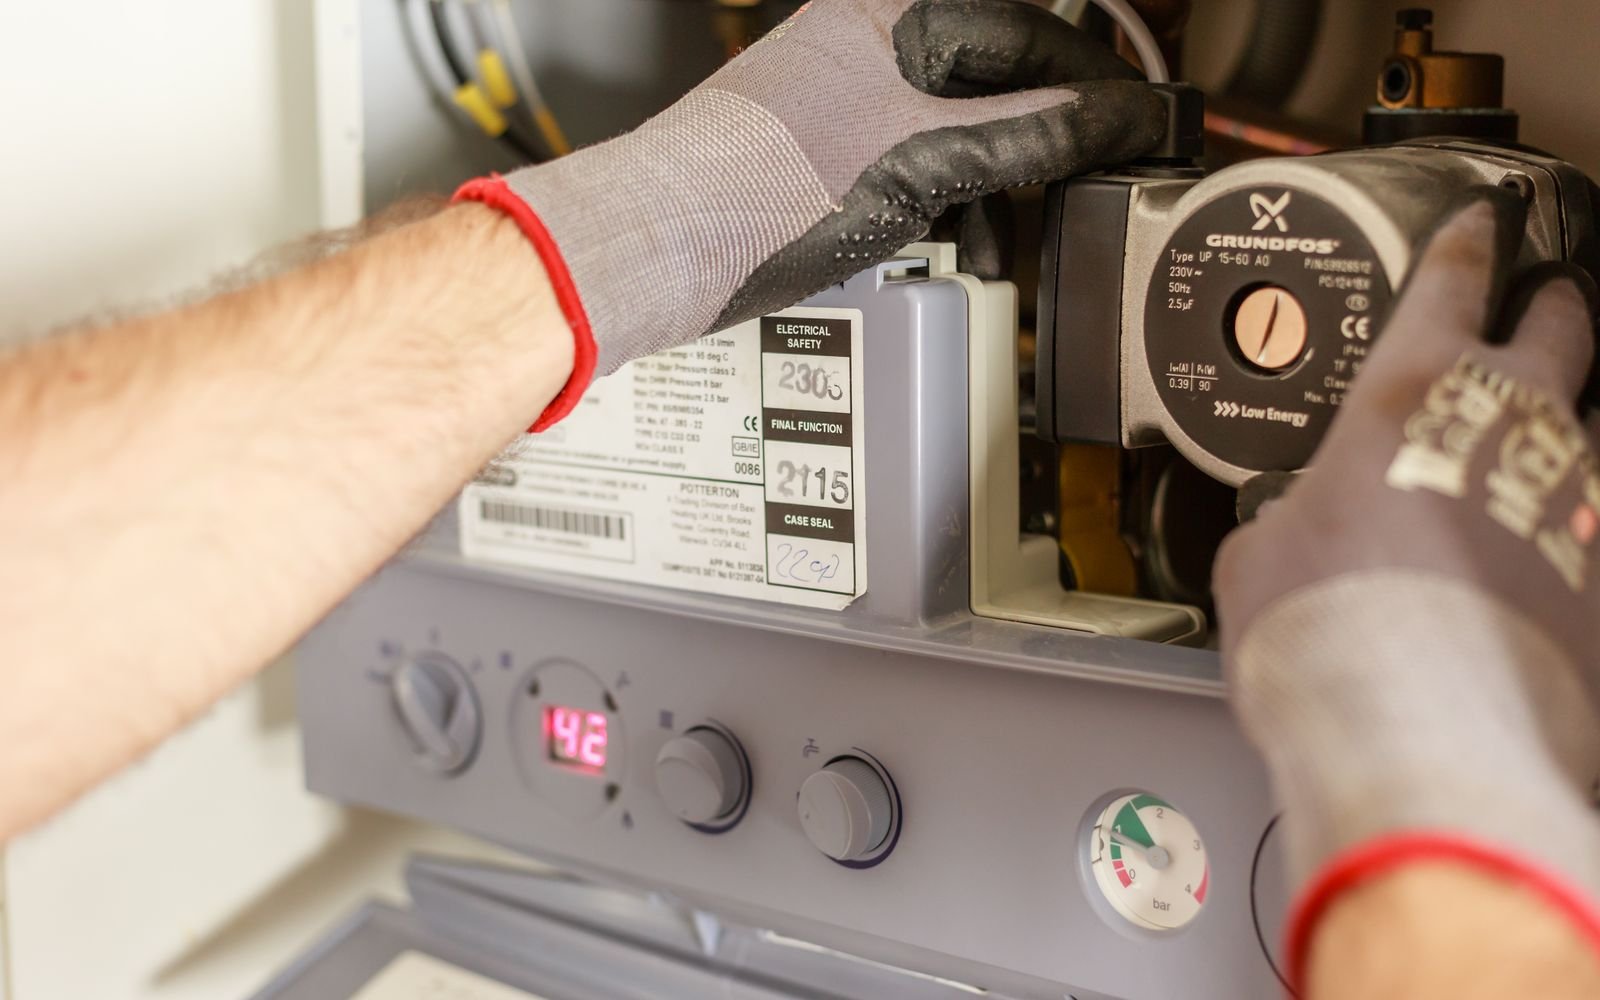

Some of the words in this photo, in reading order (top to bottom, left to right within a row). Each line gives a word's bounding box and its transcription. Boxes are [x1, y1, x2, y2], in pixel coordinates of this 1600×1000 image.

[1206, 234, 1335, 254] GRUNDFOS
[1171, 249, 1194, 262] Type
[1200, 252, 1212, 262] UP
[1218, 252, 1249, 265] 15-60
[1169, 282, 1191, 294] 50Hz
[776, 324, 831, 336] ELECTRICAL
[788, 338, 822, 349] SAFETY
[675, 364, 707, 374] Pressure
[709, 367, 729, 376] class
[731, 368, 736, 376] 2
[669, 377, 701, 388] Pressure
[710, 380, 723, 388] bar
[1170, 378, 1189, 389] 0.39
[1199, 380, 1210, 391] 90
[669, 391, 702, 401] Pressure
[717, 394, 729, 403] bar
[1242, 405, 1265, 419] Low
[1267, 408, 1308, 428] Energy
[771, 419, 796, 430] FINAL
[798, 421, 843, 434] FUNCTION
[734, 462, 760, 475] 0086
[680, 483, 740, 498] POTTERTON
[784, 514, 808, 526] CASE
[810, 518, 834, 529] SEAL
[553, 708, 607, 766] 42
[1156, 808, 1164, 818] 2
[1193, 840, 1200, 851] 3
[1129, 868, 1136, 880] 0
[1185, 884, 1191, 894] 4
[1153, 898, 1171, 911] bar
